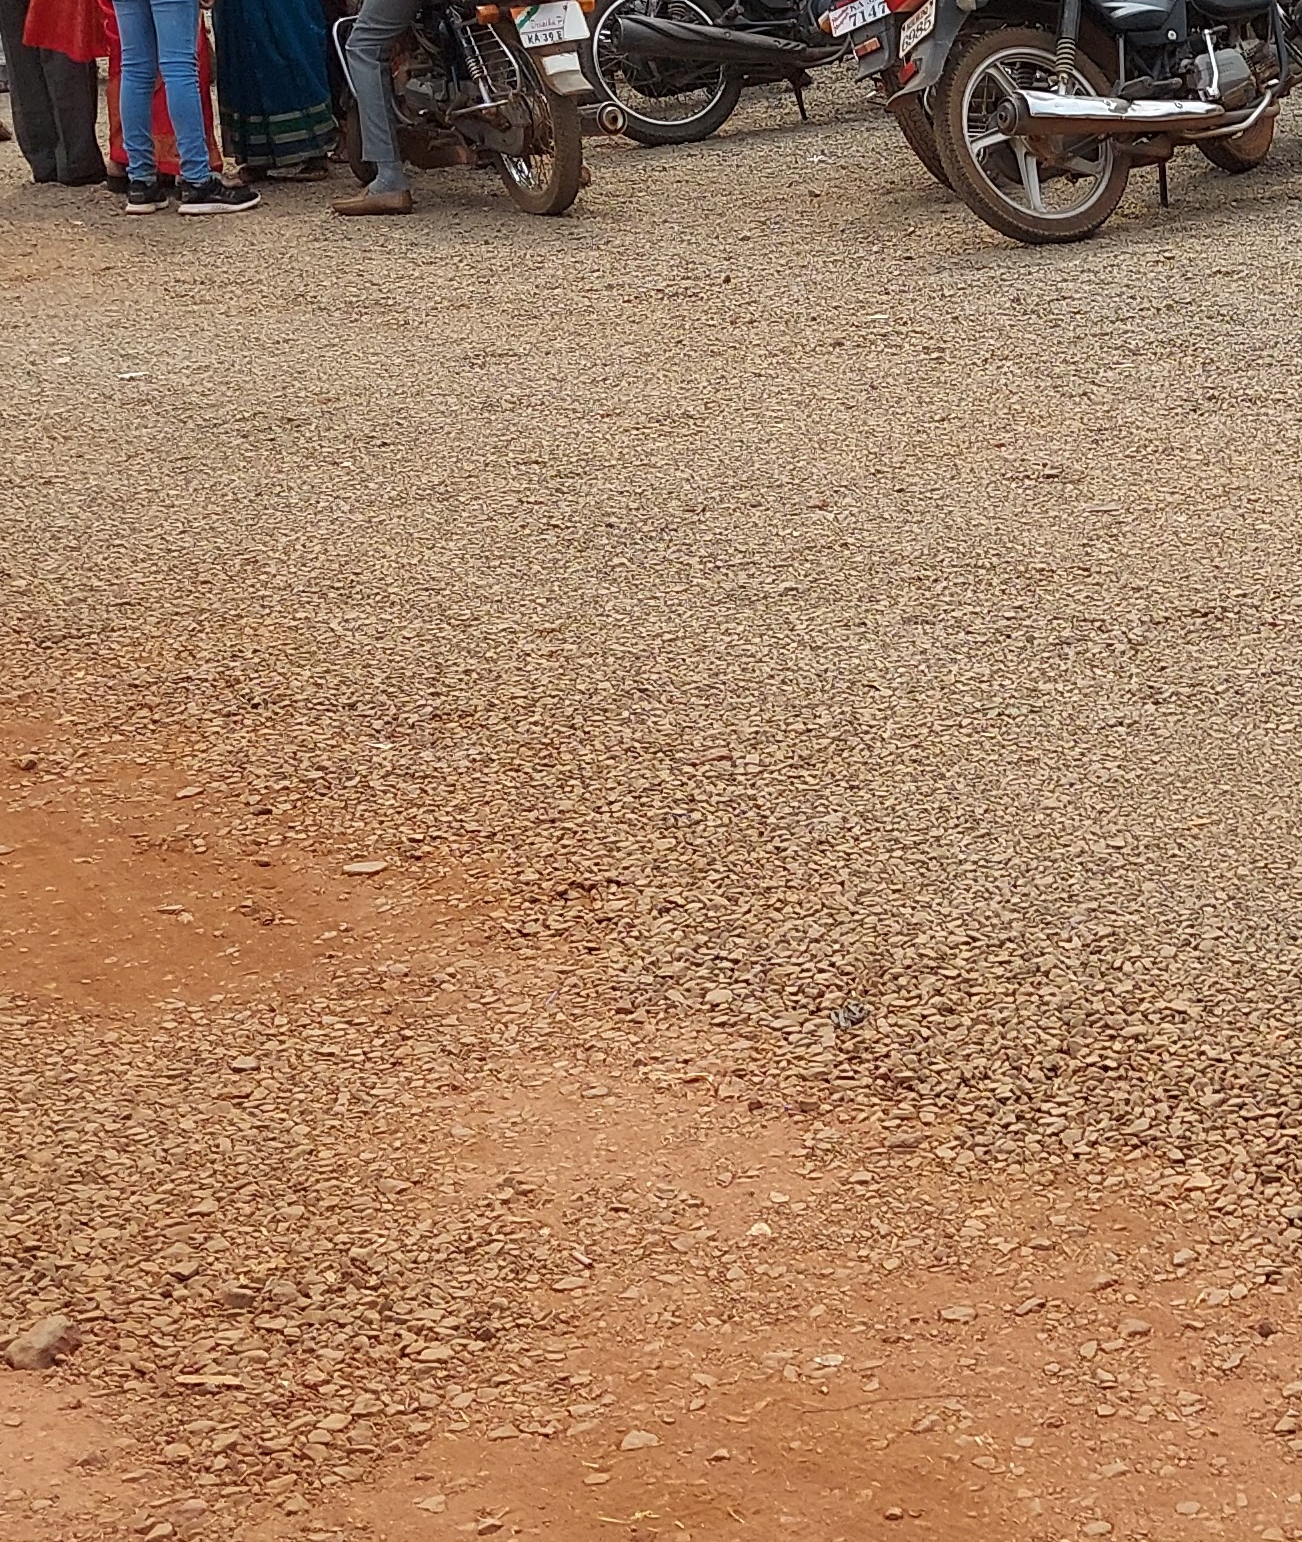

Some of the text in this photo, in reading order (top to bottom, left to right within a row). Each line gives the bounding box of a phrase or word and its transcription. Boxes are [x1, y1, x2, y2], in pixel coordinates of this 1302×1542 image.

[849, 1, 886, 27] 7147
[527, 32, 542, 45] KA
[542, 31, 555, 42] 39
